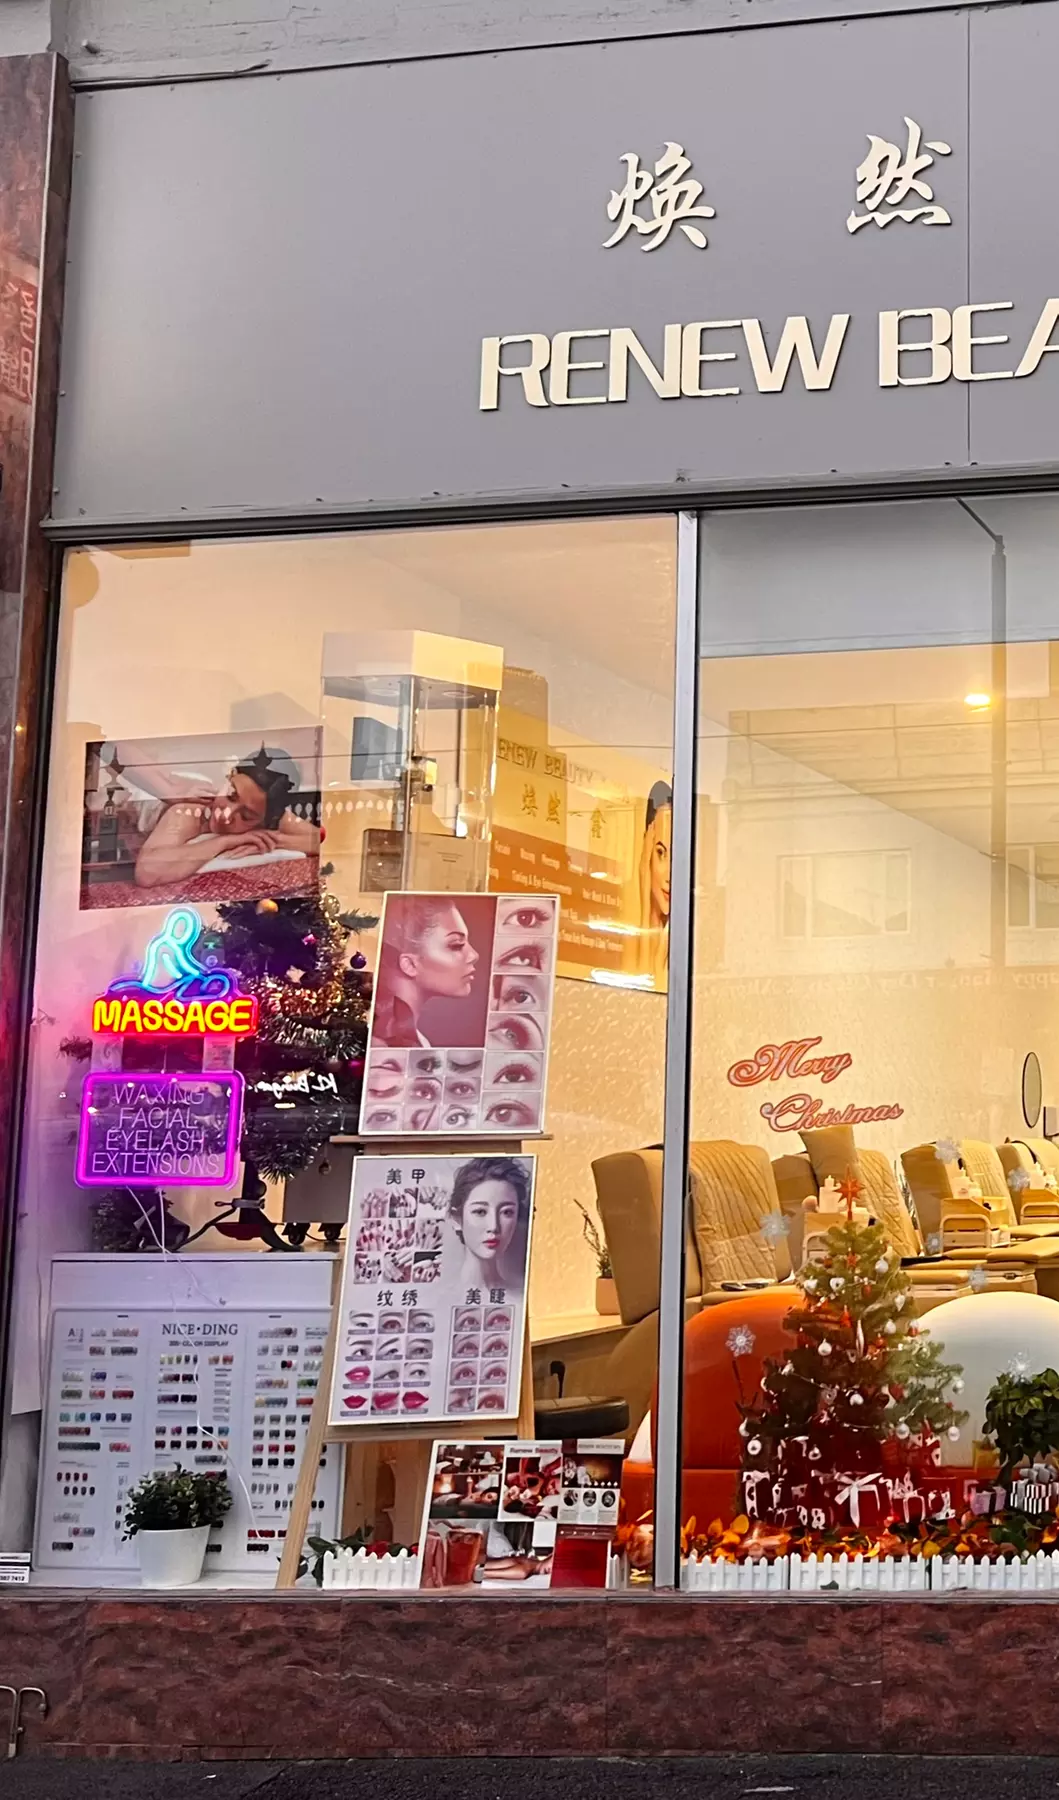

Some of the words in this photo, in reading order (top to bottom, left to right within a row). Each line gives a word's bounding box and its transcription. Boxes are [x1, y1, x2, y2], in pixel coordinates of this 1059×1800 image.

[479, 314, 850, 411] RENEW
[94, 1000, 252, 1032] MASSAGE
[727, 1036, 852, 1087] Merry
[114, 1083, 205, 1105] WAXING
[119, 1106, 198, 1129] FACIAL
[760, 1093, 904, 1132] Christmas
[106, 1130, 205, 1151] EYELASH
[92, 1153, 220, 1174] EXTENSIONS
[386, 1168, 426, 1185] 美甲
